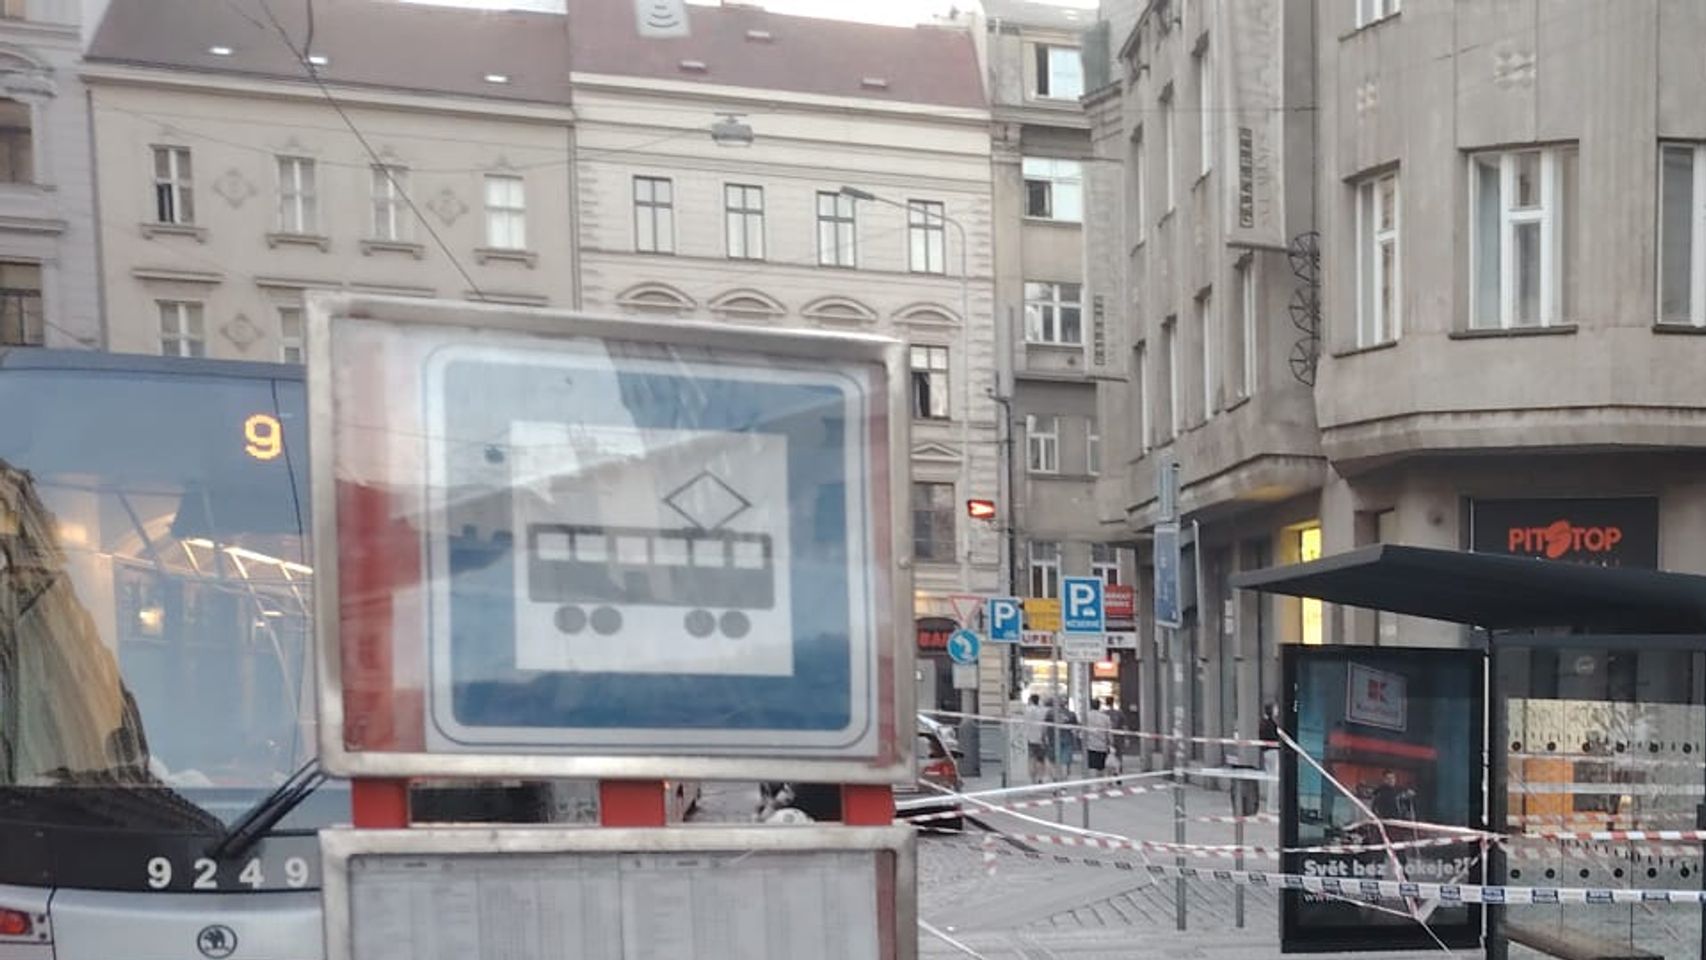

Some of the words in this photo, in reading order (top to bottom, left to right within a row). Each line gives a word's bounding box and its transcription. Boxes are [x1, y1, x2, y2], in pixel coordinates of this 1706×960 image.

[245, 414, 282, 459] 9
[994, 602, 1014, 628] P
[1071, 583, 1095, 617] P
[147, 856, 309, 889] 9249
[1304, 858, 1348, 876] Svět
[1353, 859, 1386, 876] bez
[1394, 857, 1470, 878] okeje?!
